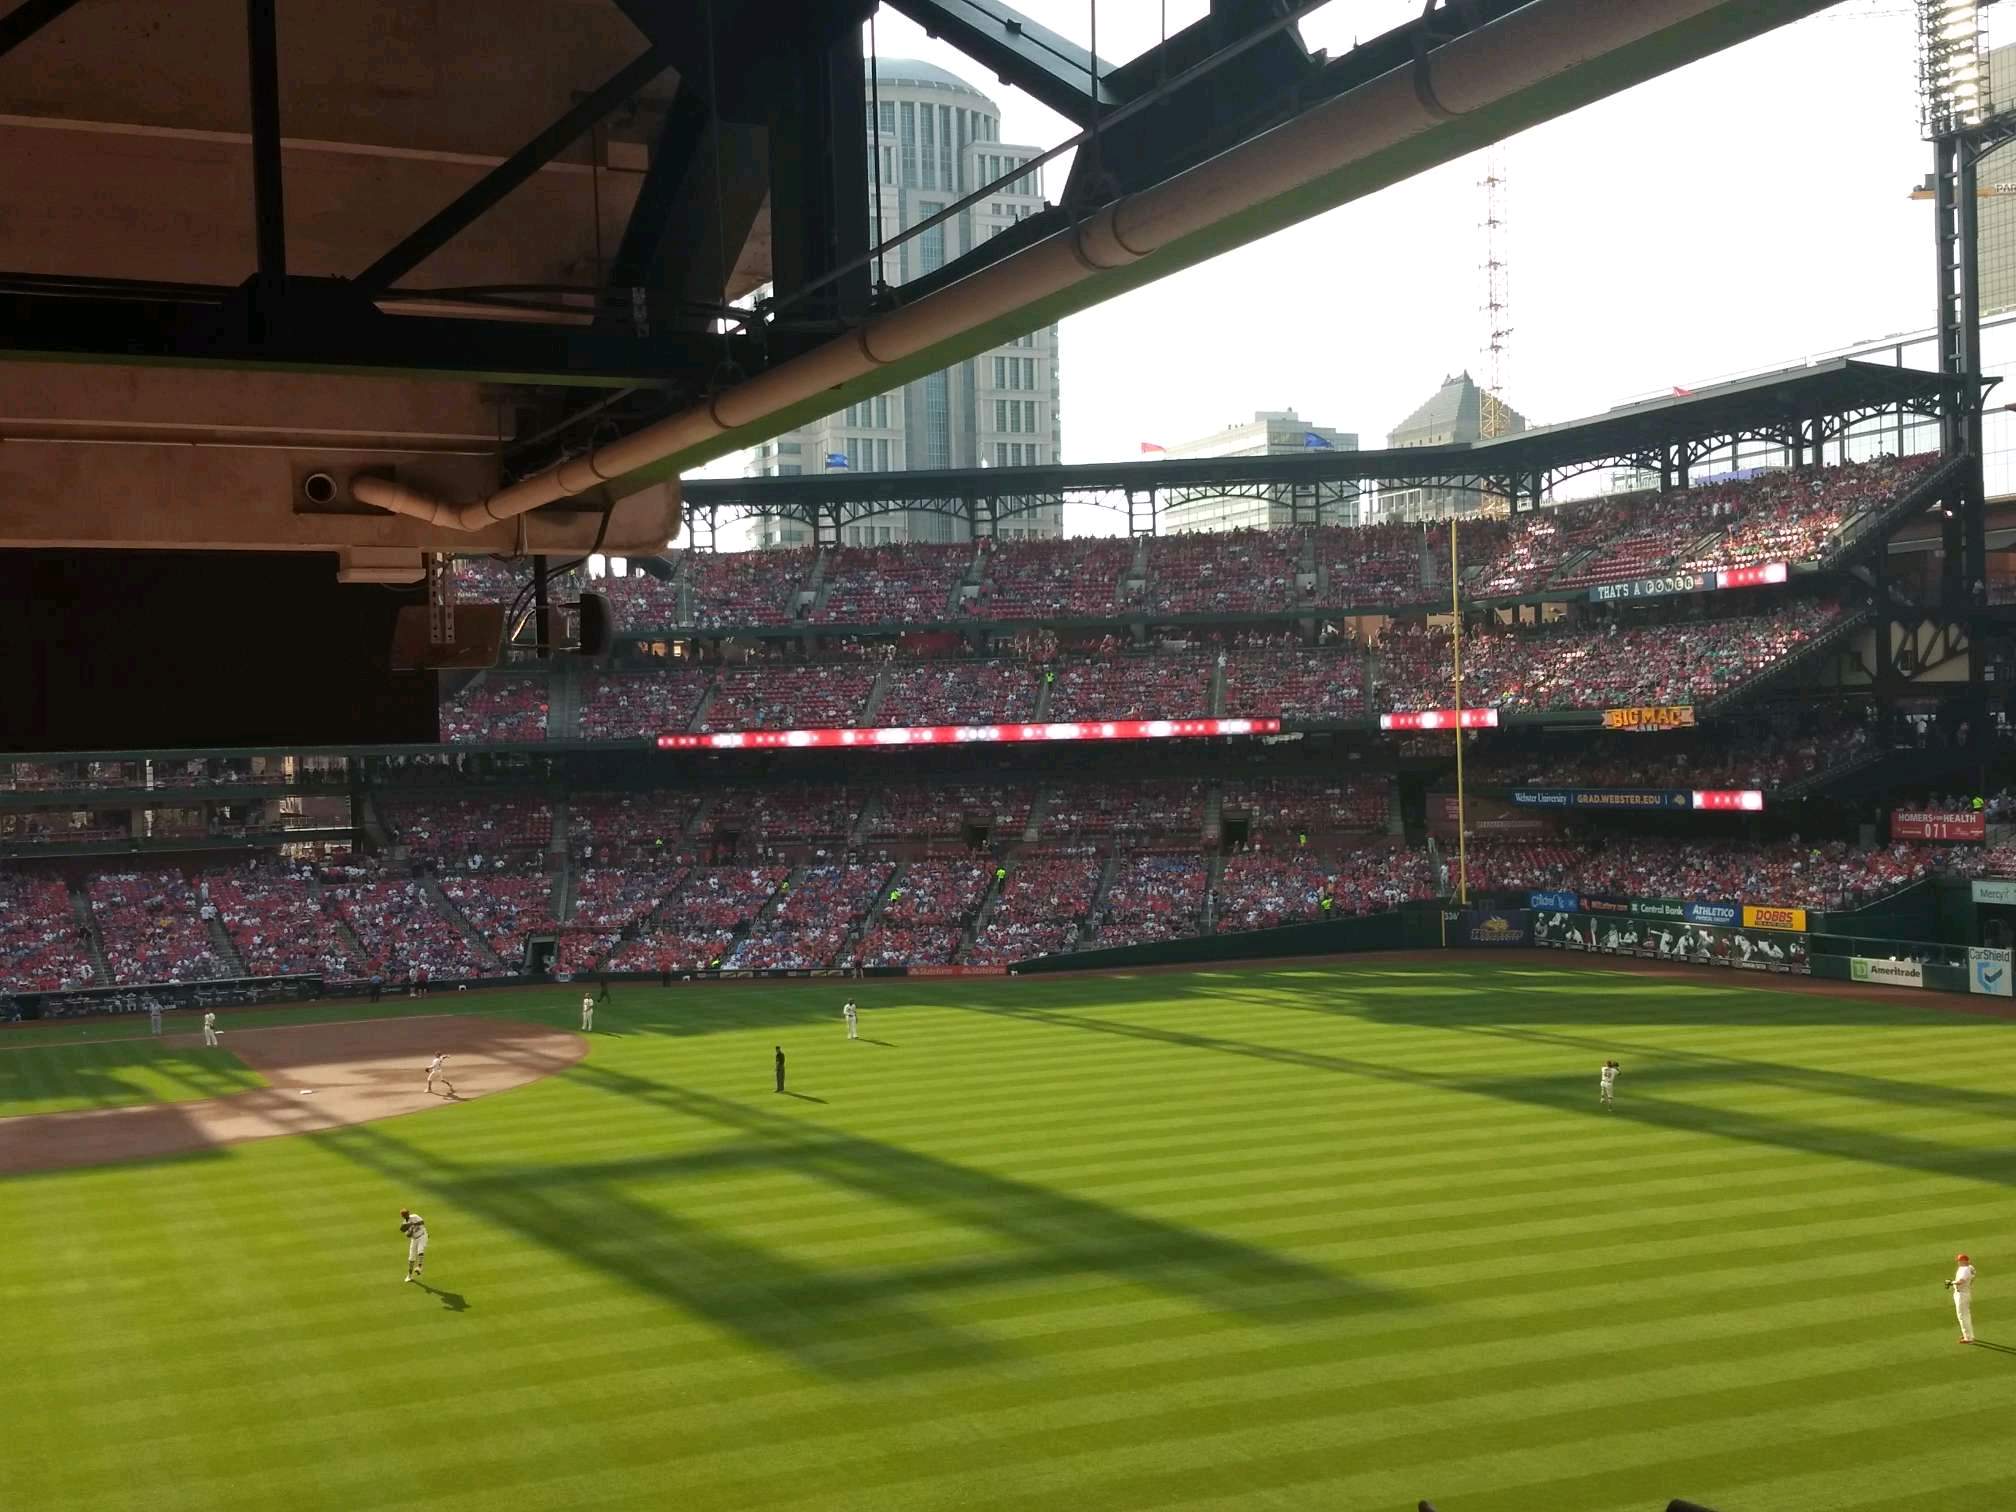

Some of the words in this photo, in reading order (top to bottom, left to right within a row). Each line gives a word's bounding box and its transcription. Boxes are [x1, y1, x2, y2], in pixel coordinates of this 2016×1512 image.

[1598, 583, 1629, 599] THAT'S
[1634, 582, 1641, 595] A
[1612, 709, 1640, 727] BIG
[1641, 708, 1682, 725] MAC
[1515, 792, 1536, 803] Webster
[1537, 793, 1567, 805] University
[1577, 795, 1661, 805] GRAD.WEBSTER.EDU
[1899, 813, 1933, 822] HOMERS
[1943, 814, 1977, 823] HEALTH
[1924, 823, 1947, 838] 071
[1640, 903, 1664, 914] Central
[1665, 905, 1684, 916] Bank
[1692, 904, 1735, 917] ATHLETICO
[1755, 909, 1793, 922] DOBBS
[1969, 949, 2010, 962] CarShield
[1871, 965, 1921, 978] Ameritrade
